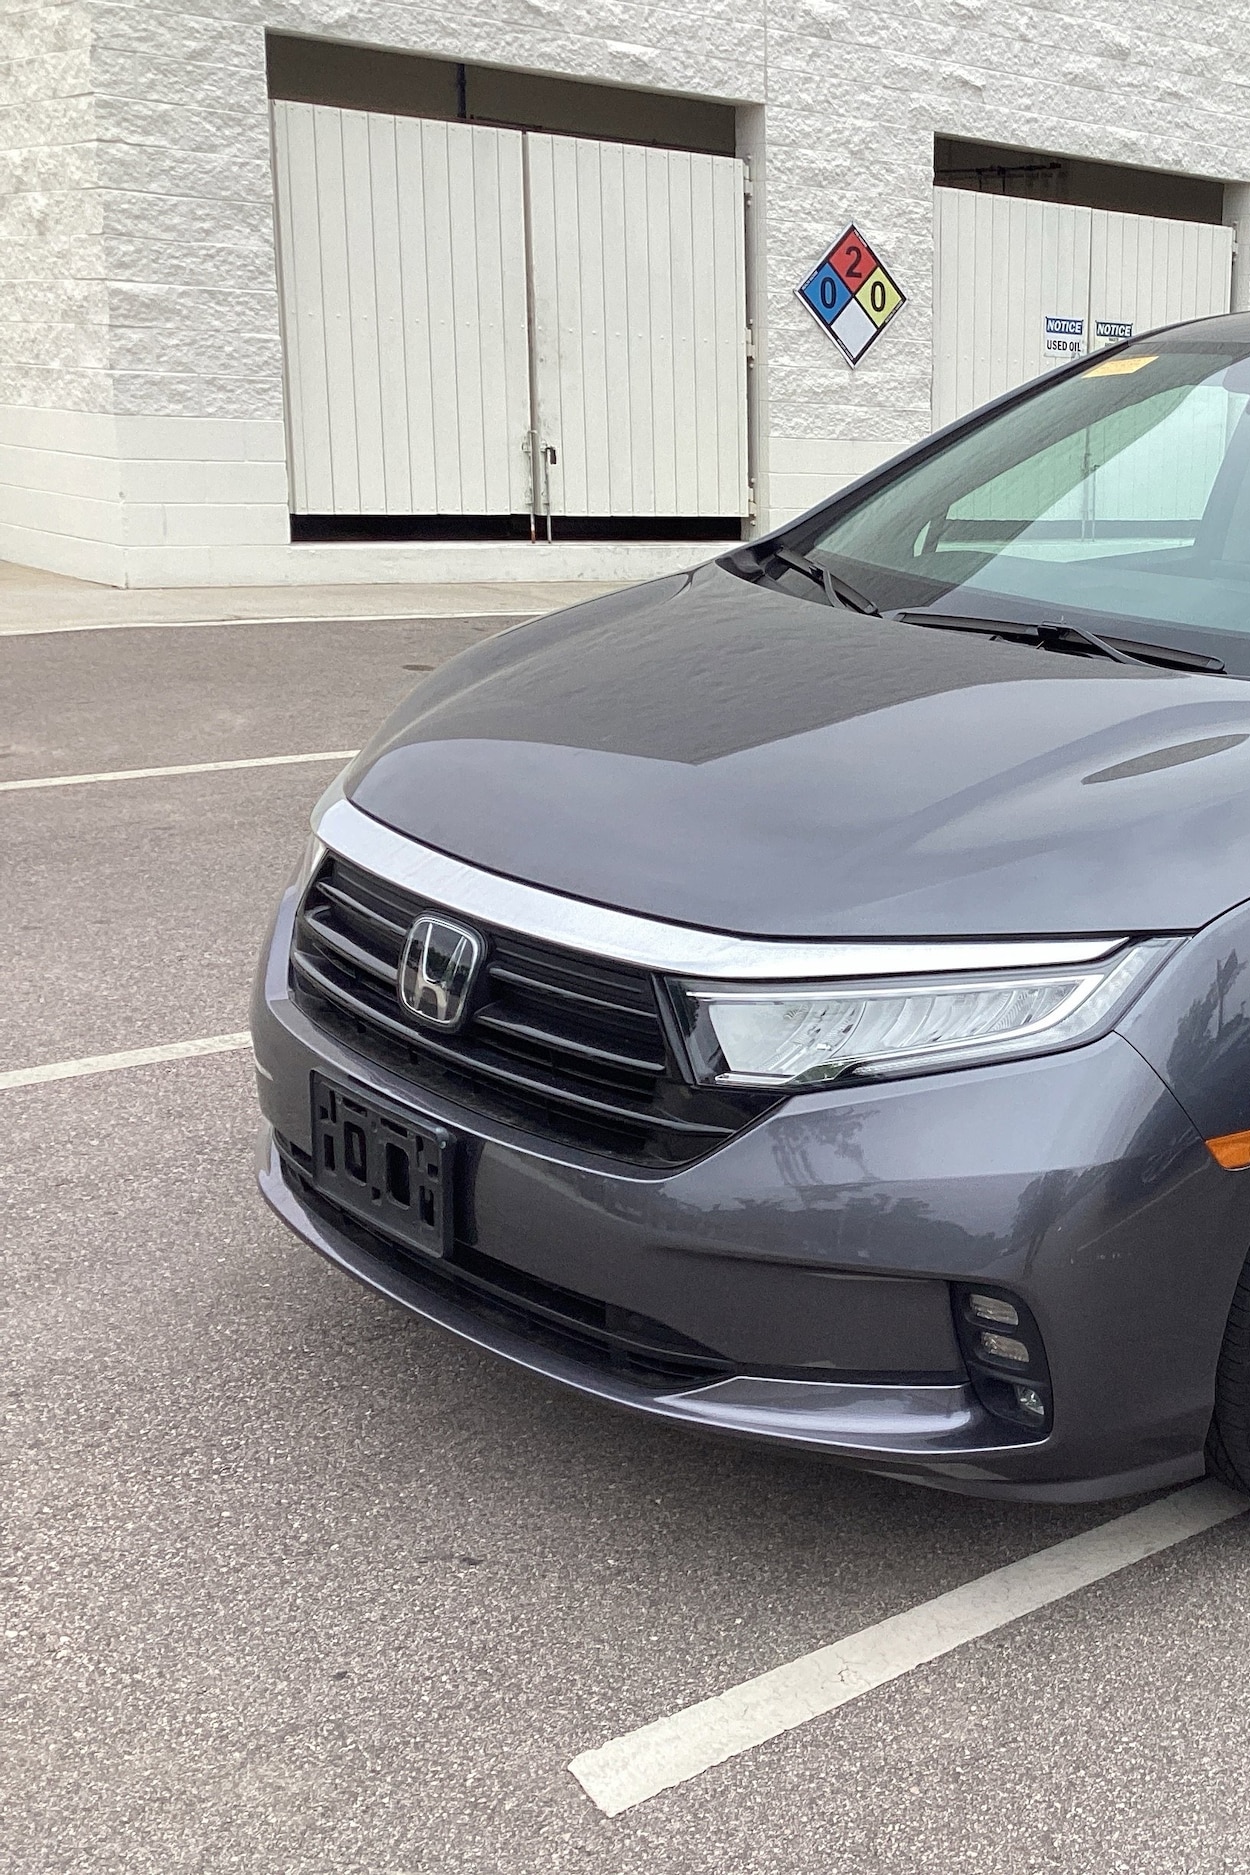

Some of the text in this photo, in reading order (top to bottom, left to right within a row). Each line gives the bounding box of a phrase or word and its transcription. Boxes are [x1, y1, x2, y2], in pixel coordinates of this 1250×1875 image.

[845, 246, 863, 278] 2
[820, 276, 837, 309] 0
[870, 281, 886, 312] 0
[1047, 319, 1082, 333] NOTICE
[1097, 323, 1132, 337] NOTICE
[1046, 339, 1081, 352] USED OIL
